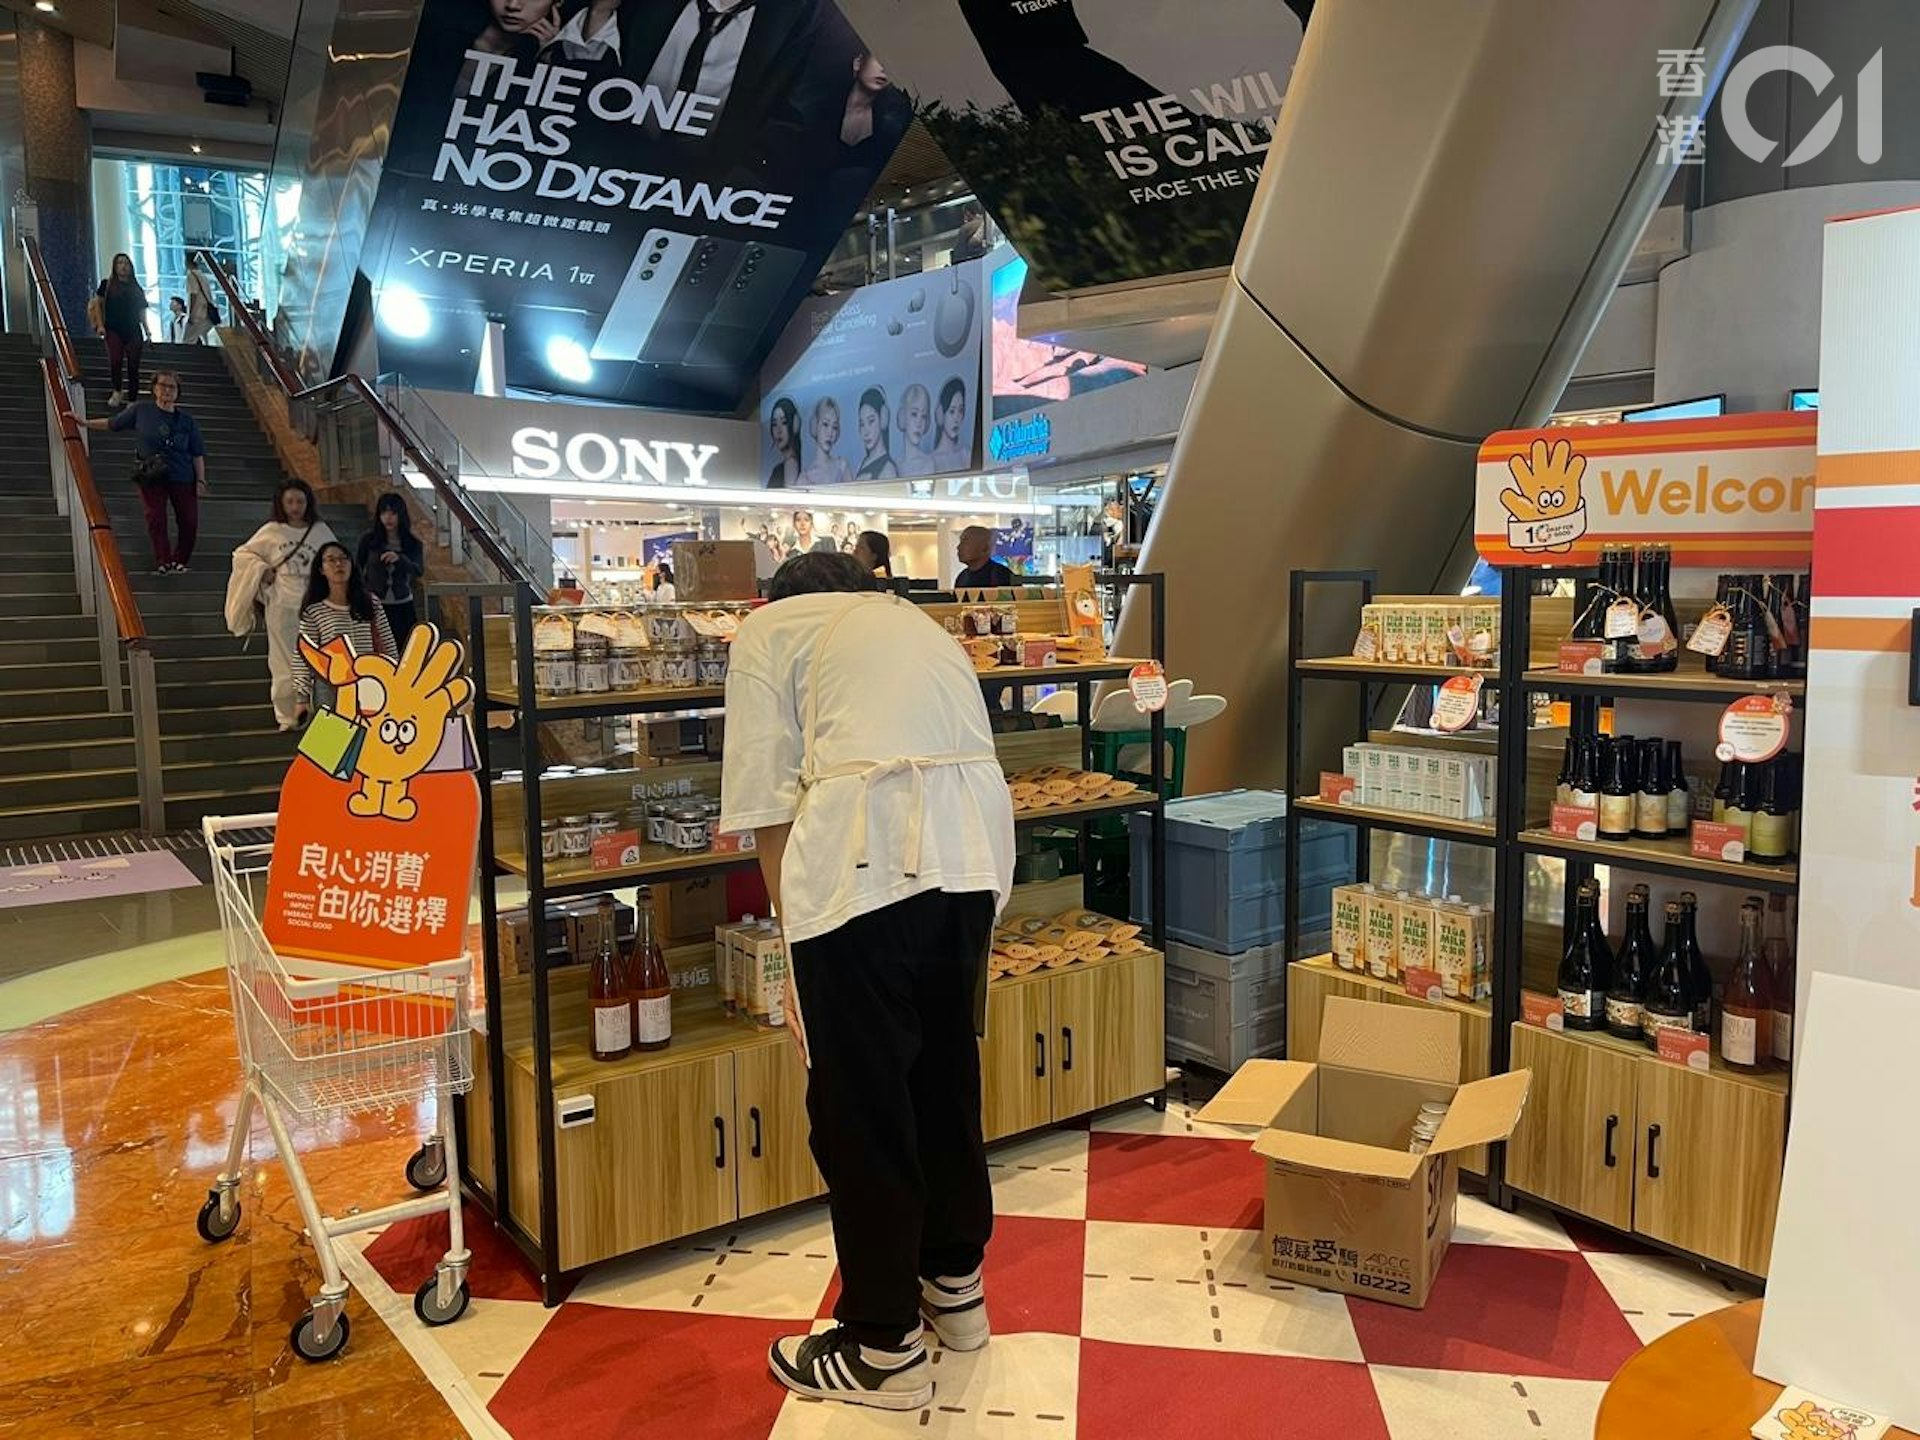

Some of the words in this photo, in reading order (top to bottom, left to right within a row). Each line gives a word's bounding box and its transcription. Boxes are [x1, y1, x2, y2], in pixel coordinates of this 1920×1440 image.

[464, 49, 586, 111] THE
[588, 78, 720, 136] ONE
[1080, 94, 1191, 144] THE
[1191, 67, 1296, 120] WIL
[445, 98, 576, 155] HAS
[1105, 144, 1158, 180] IS
[432, 144, 533, 191] NO
[536, 161, 793, 229] DISTANCE
[1129, 180, 1192, 205] FACE
[1191, 168, 1244, 193] THE
[405, 247, 554, 281] XPERIA
[511, 427, 719, 486] SONY
[298, 842, 425, 893] 良心消費
[283, 891, 315, 901] EMPOWER
[283, 910, 313, 920] EMBRACE
[289, 901, 314, 911] IMPACT
[317, 885, 448, 936] 由你選擇
[1336, 901, 1360, 914] TIGA
[1369, 909, 1393, 921] TIGA
[287, 918, 312, 928] SOCIAL
[312, 921, 332, 931] GOOD
[1336, 911, 1360, 923] MILK
[1369, 918, 1393, 931] MILK
[1403, 917, 1427, 929] TIGA
[1403, 926, 1427, 939] MILK
[1440, 925, 1466, 938] TIGA
[1440, 934, 1466, 948] MILK
[1272, 1234, 1359, 1268] 懷疑受騙
[1352, 1272, 1411, 1295] 18222
